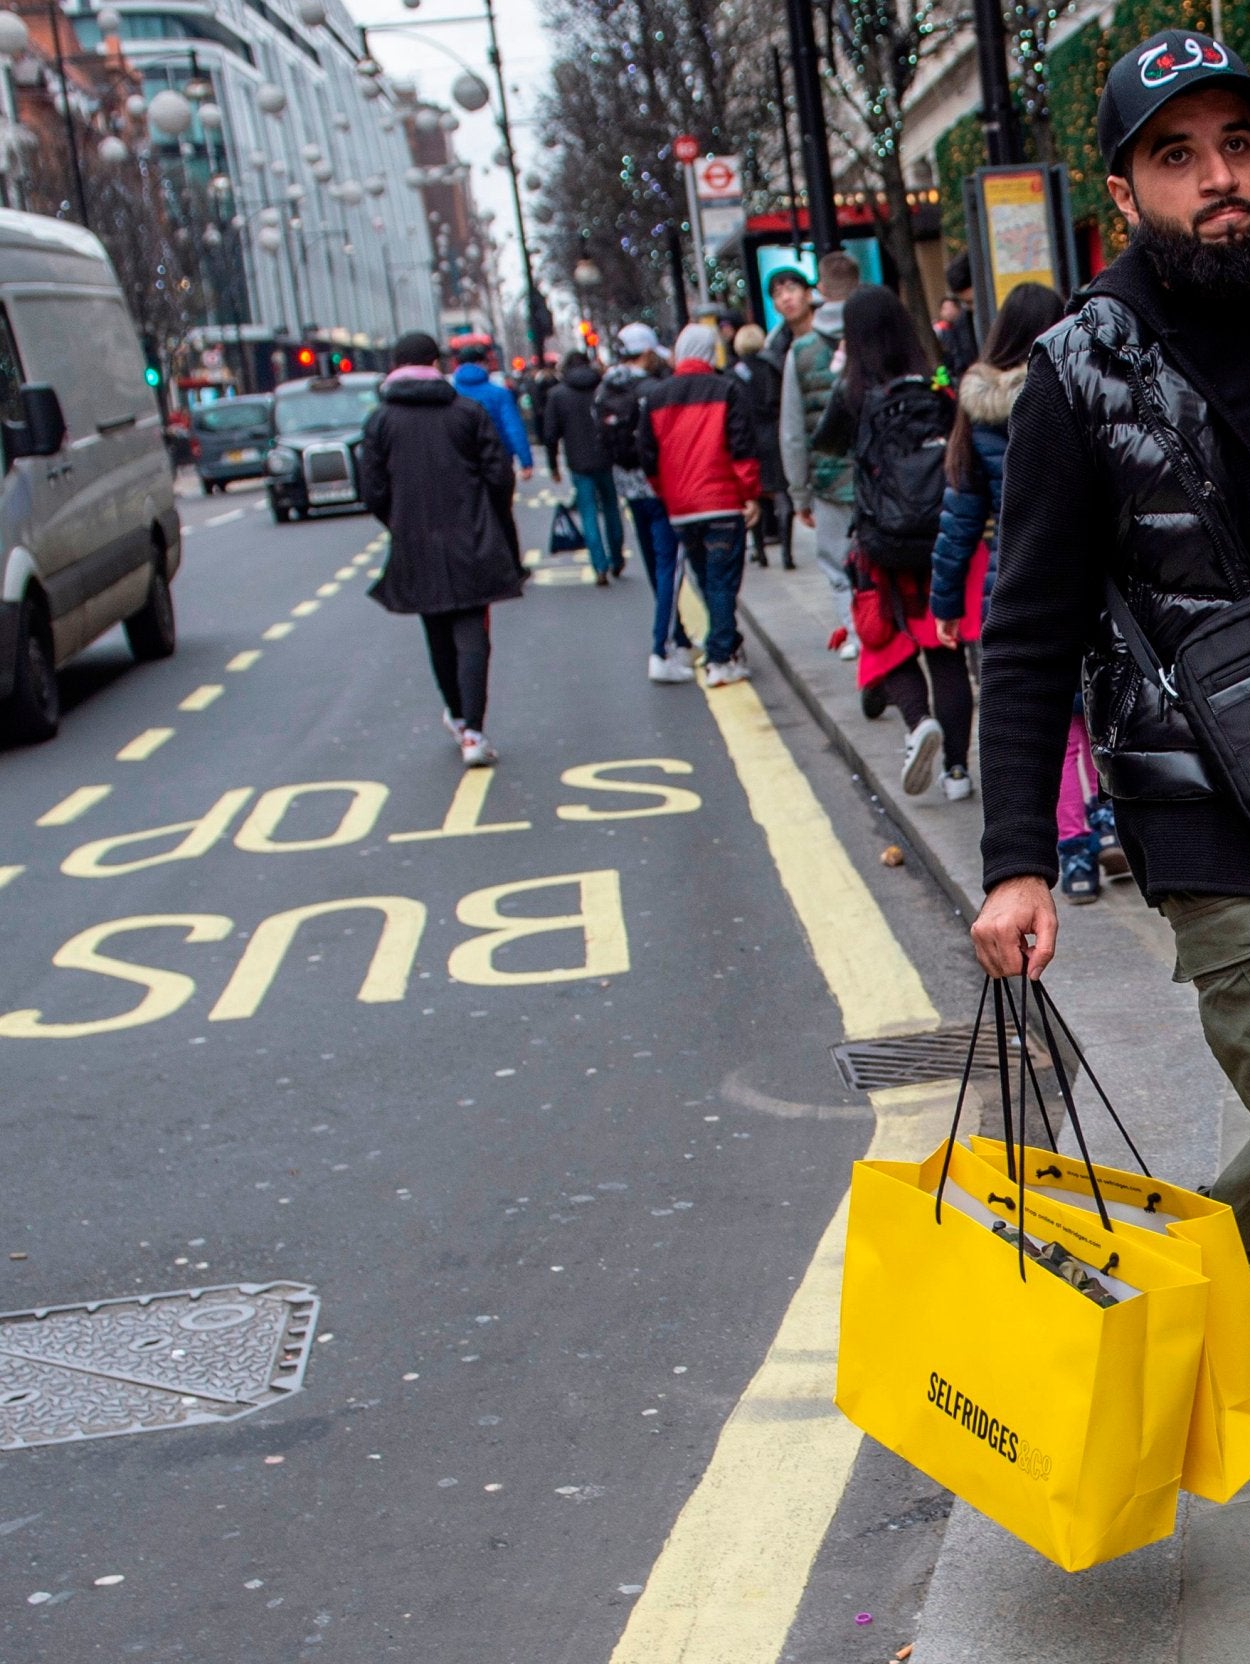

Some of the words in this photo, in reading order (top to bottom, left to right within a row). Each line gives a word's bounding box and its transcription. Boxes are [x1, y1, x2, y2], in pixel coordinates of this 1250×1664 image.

[1137, 38, 1228, 89] روح
[60, 758, 702, 878] STOP
[0, 869, 630, 1038] BUS
